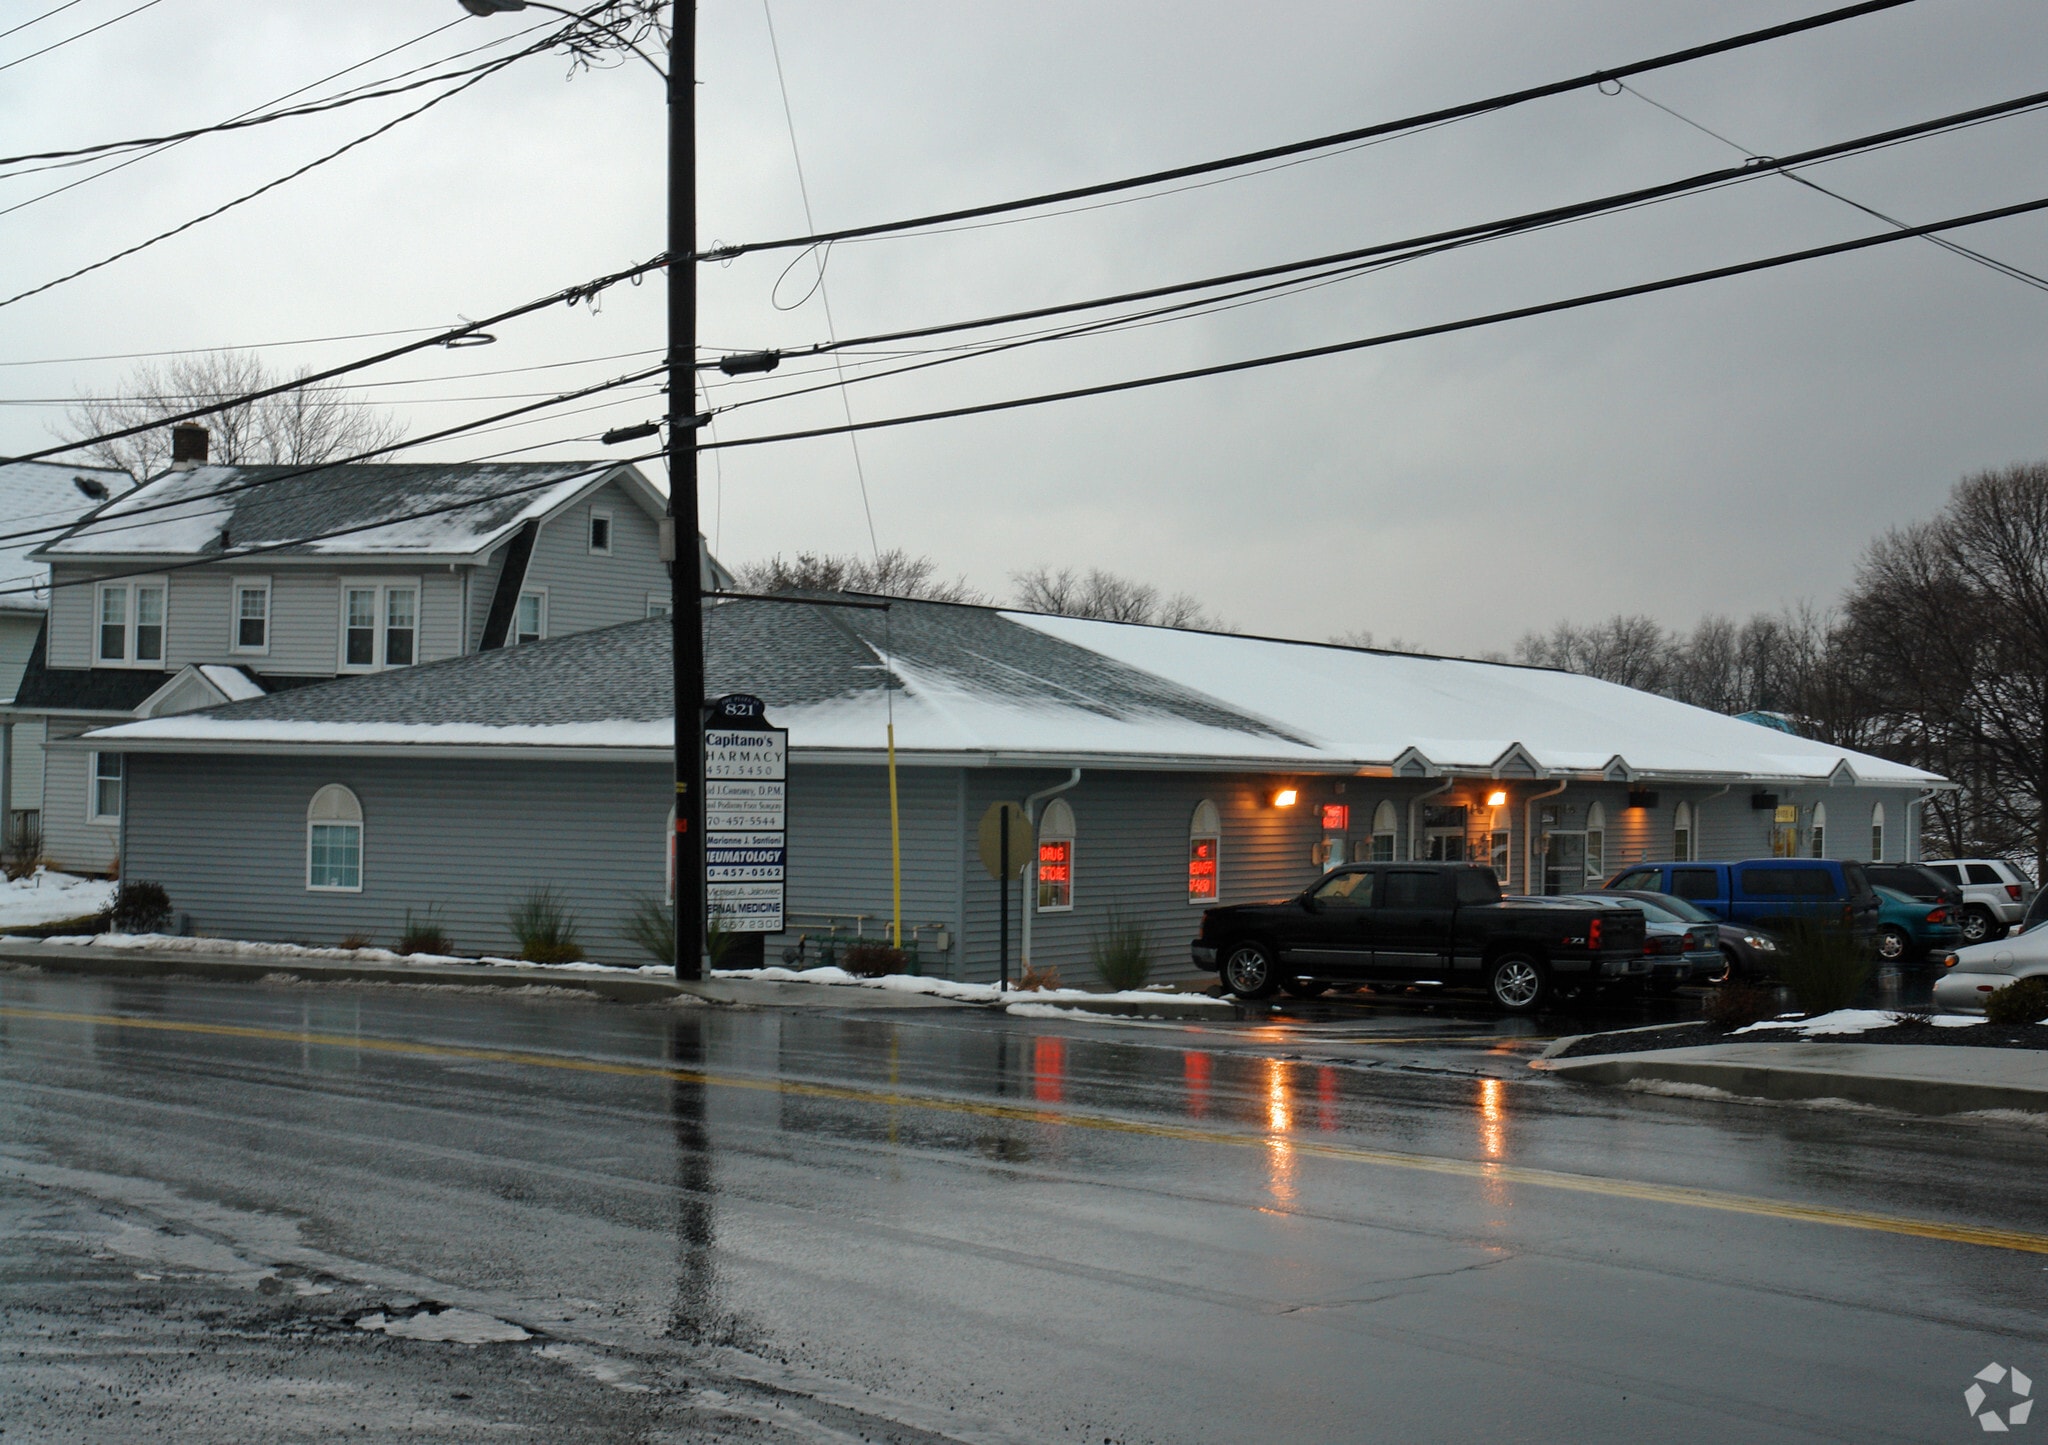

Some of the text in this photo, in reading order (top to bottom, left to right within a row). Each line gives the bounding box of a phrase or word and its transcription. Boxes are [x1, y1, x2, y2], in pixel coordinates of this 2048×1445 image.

[725, 703, 754, 716] 821
[706, 733, 773, 748] Capitano's
[706, 751, 782, 762] HARMACY
[708, 816, 775, 826] 70-457-5544
[707, 851, 781, 863] EUMATOLOGY
[1040, 846, 1064, 861] DRUG
[709, 868, 780, 877] 0-457-0562
[1040, 866, 1066, 881] STORE
[707, 902, 780, 914] ERNAL MEDICINE
